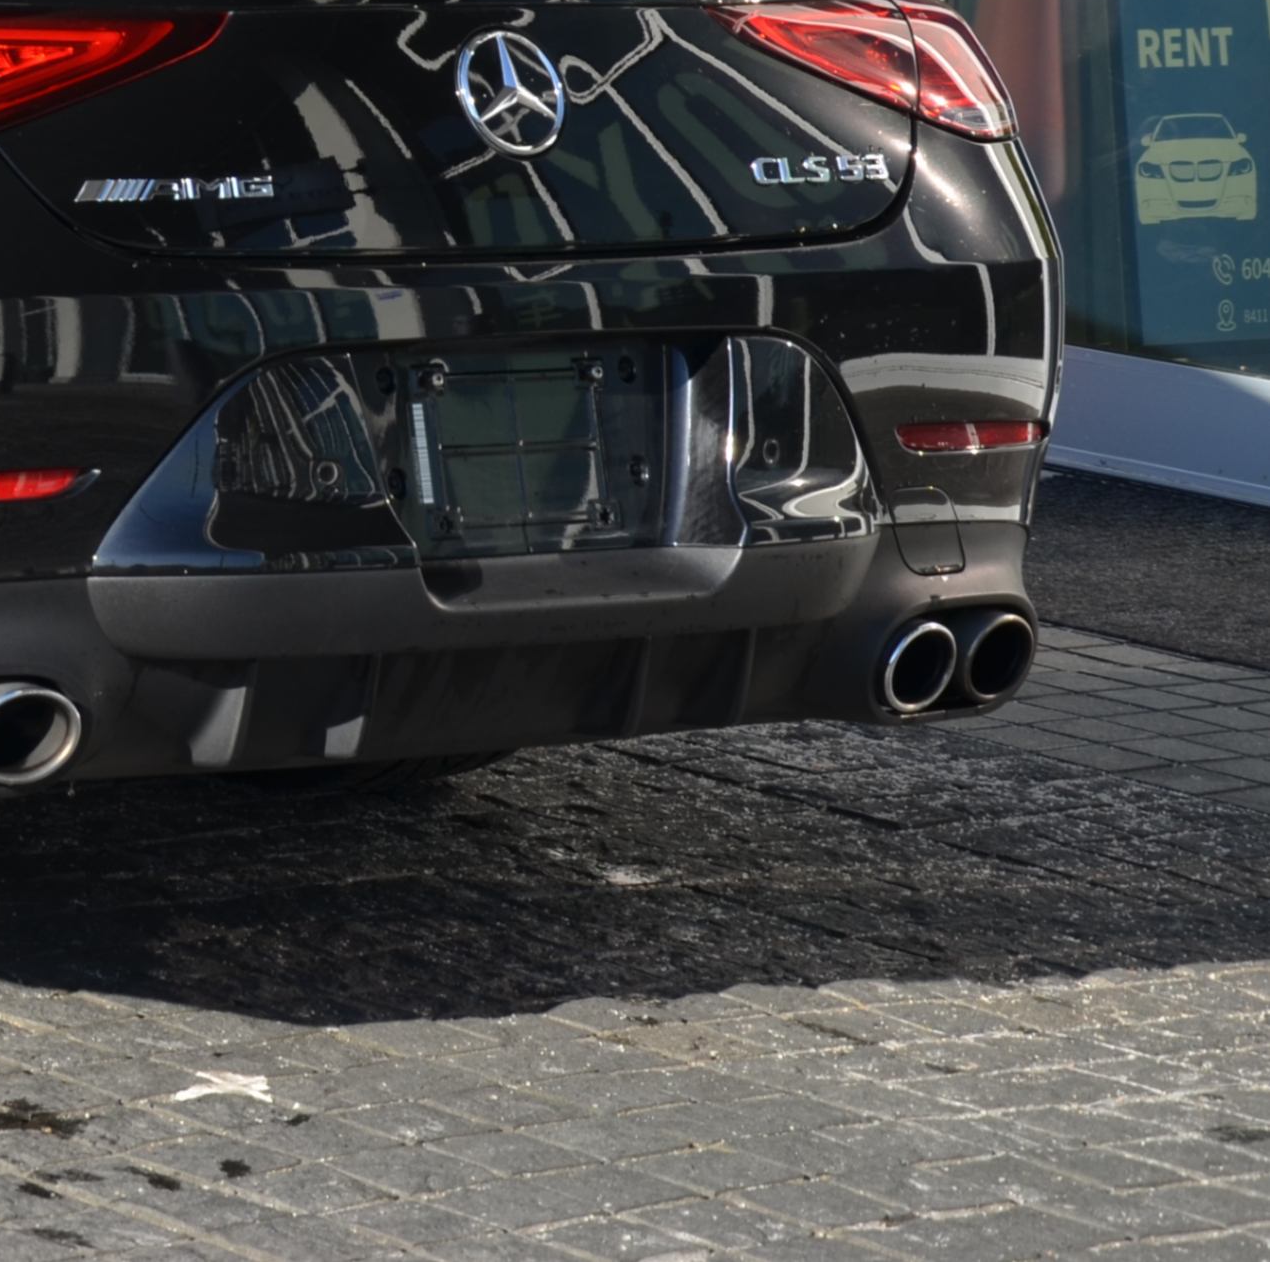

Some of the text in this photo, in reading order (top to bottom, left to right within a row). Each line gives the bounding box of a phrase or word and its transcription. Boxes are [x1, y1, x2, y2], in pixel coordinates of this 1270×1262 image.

[1137, 27, 1233, 69] RENT
[750, 153, 889, 184] CLS 53
